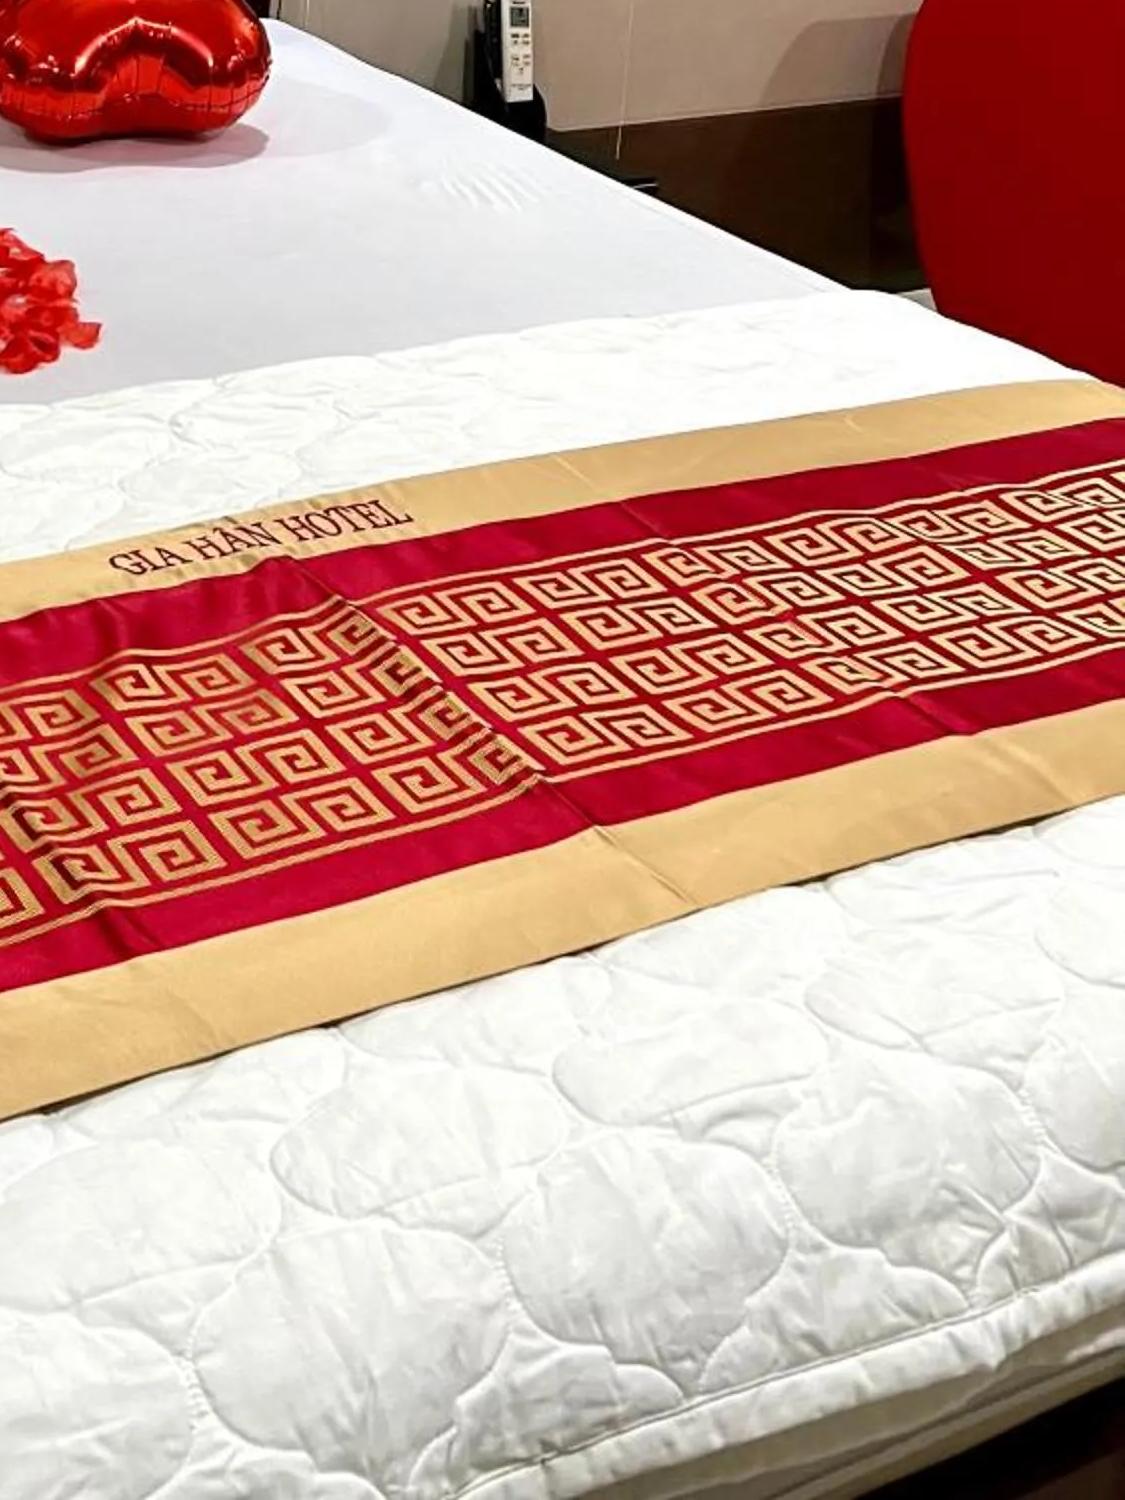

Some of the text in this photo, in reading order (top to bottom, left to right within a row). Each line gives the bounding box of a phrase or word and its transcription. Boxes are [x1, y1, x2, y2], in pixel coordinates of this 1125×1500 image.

[108, 499, 414, 576] GIA HÂN HOTEL
